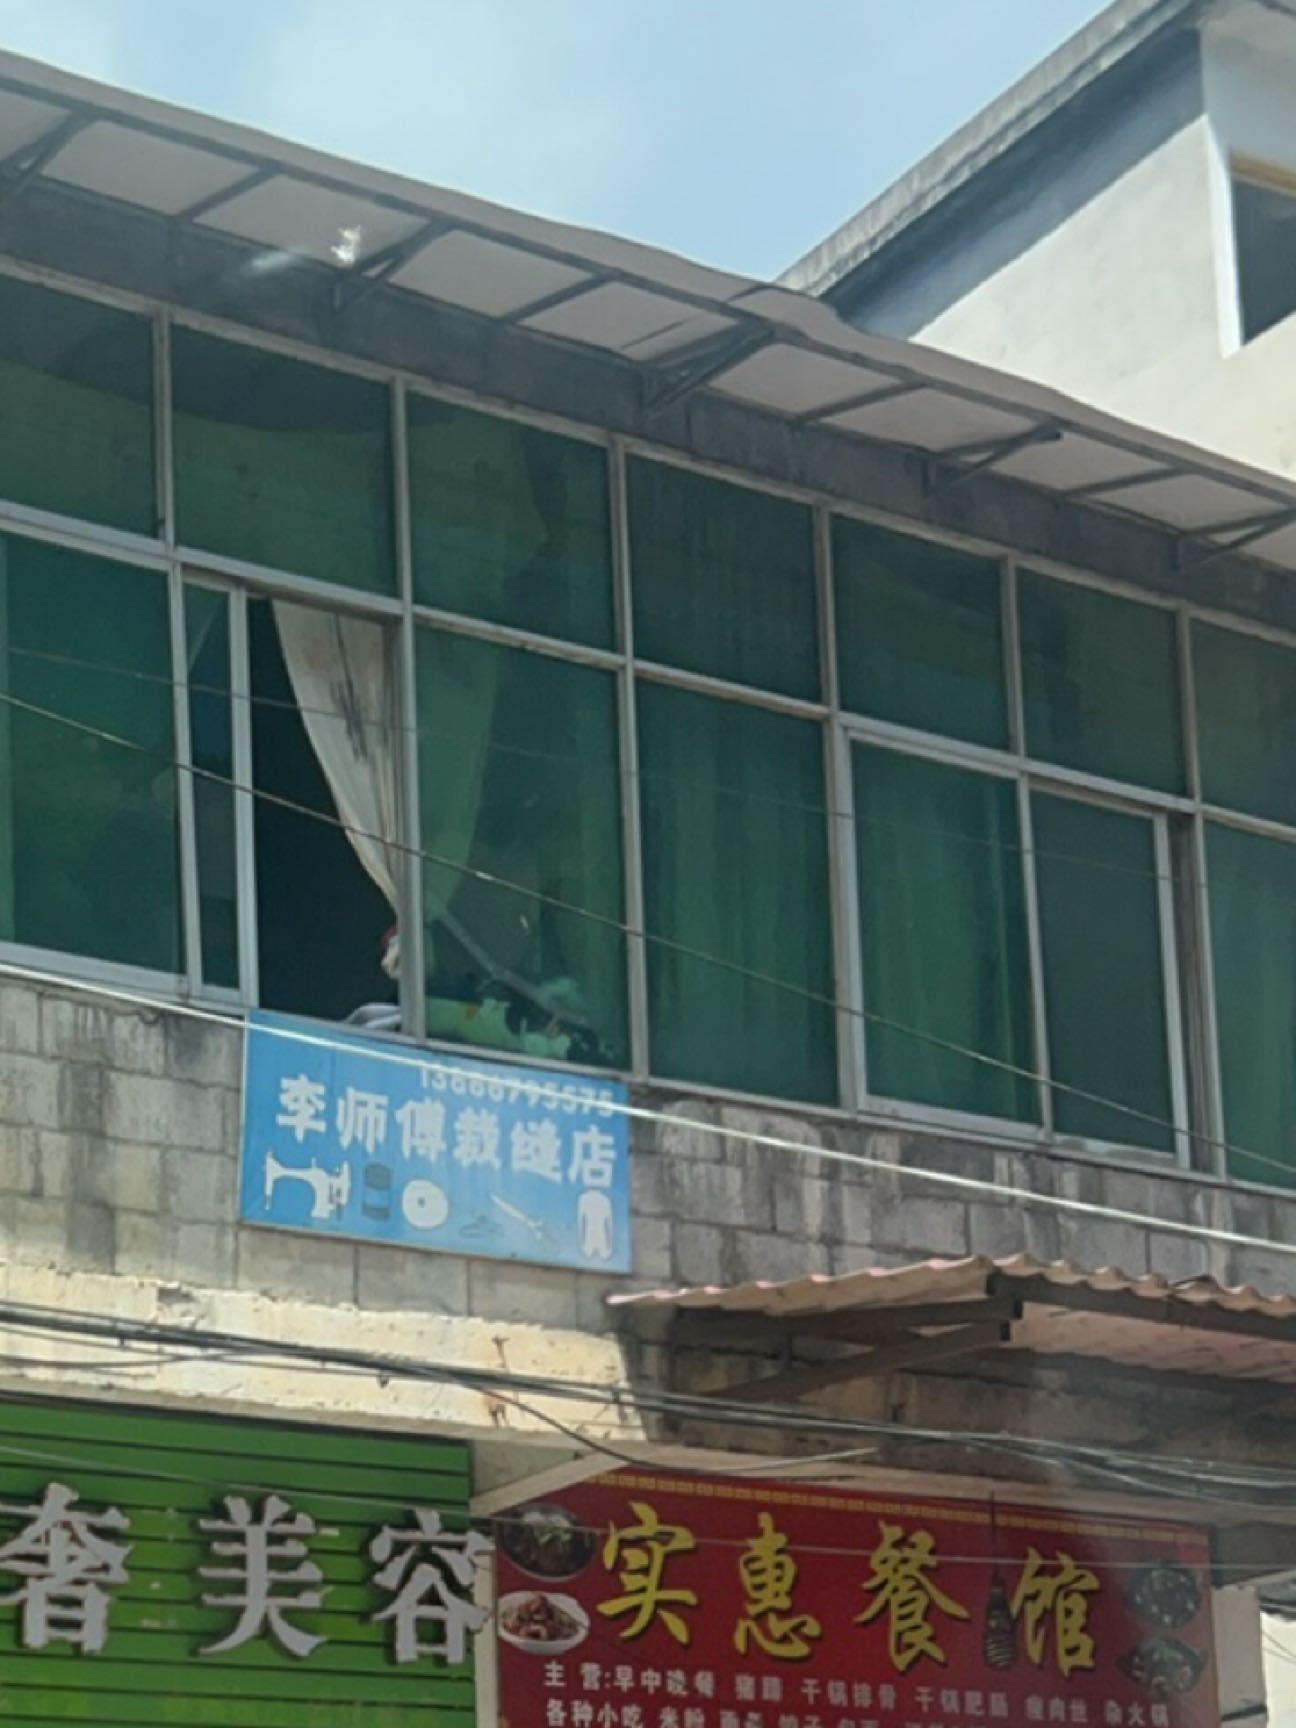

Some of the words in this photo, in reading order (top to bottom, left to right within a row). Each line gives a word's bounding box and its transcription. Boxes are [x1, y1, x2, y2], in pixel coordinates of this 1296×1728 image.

[276, 1073, 616, 1188] 李师傅裁缝店
[596, 1501, 1102, 1678] 实惠餐馆
